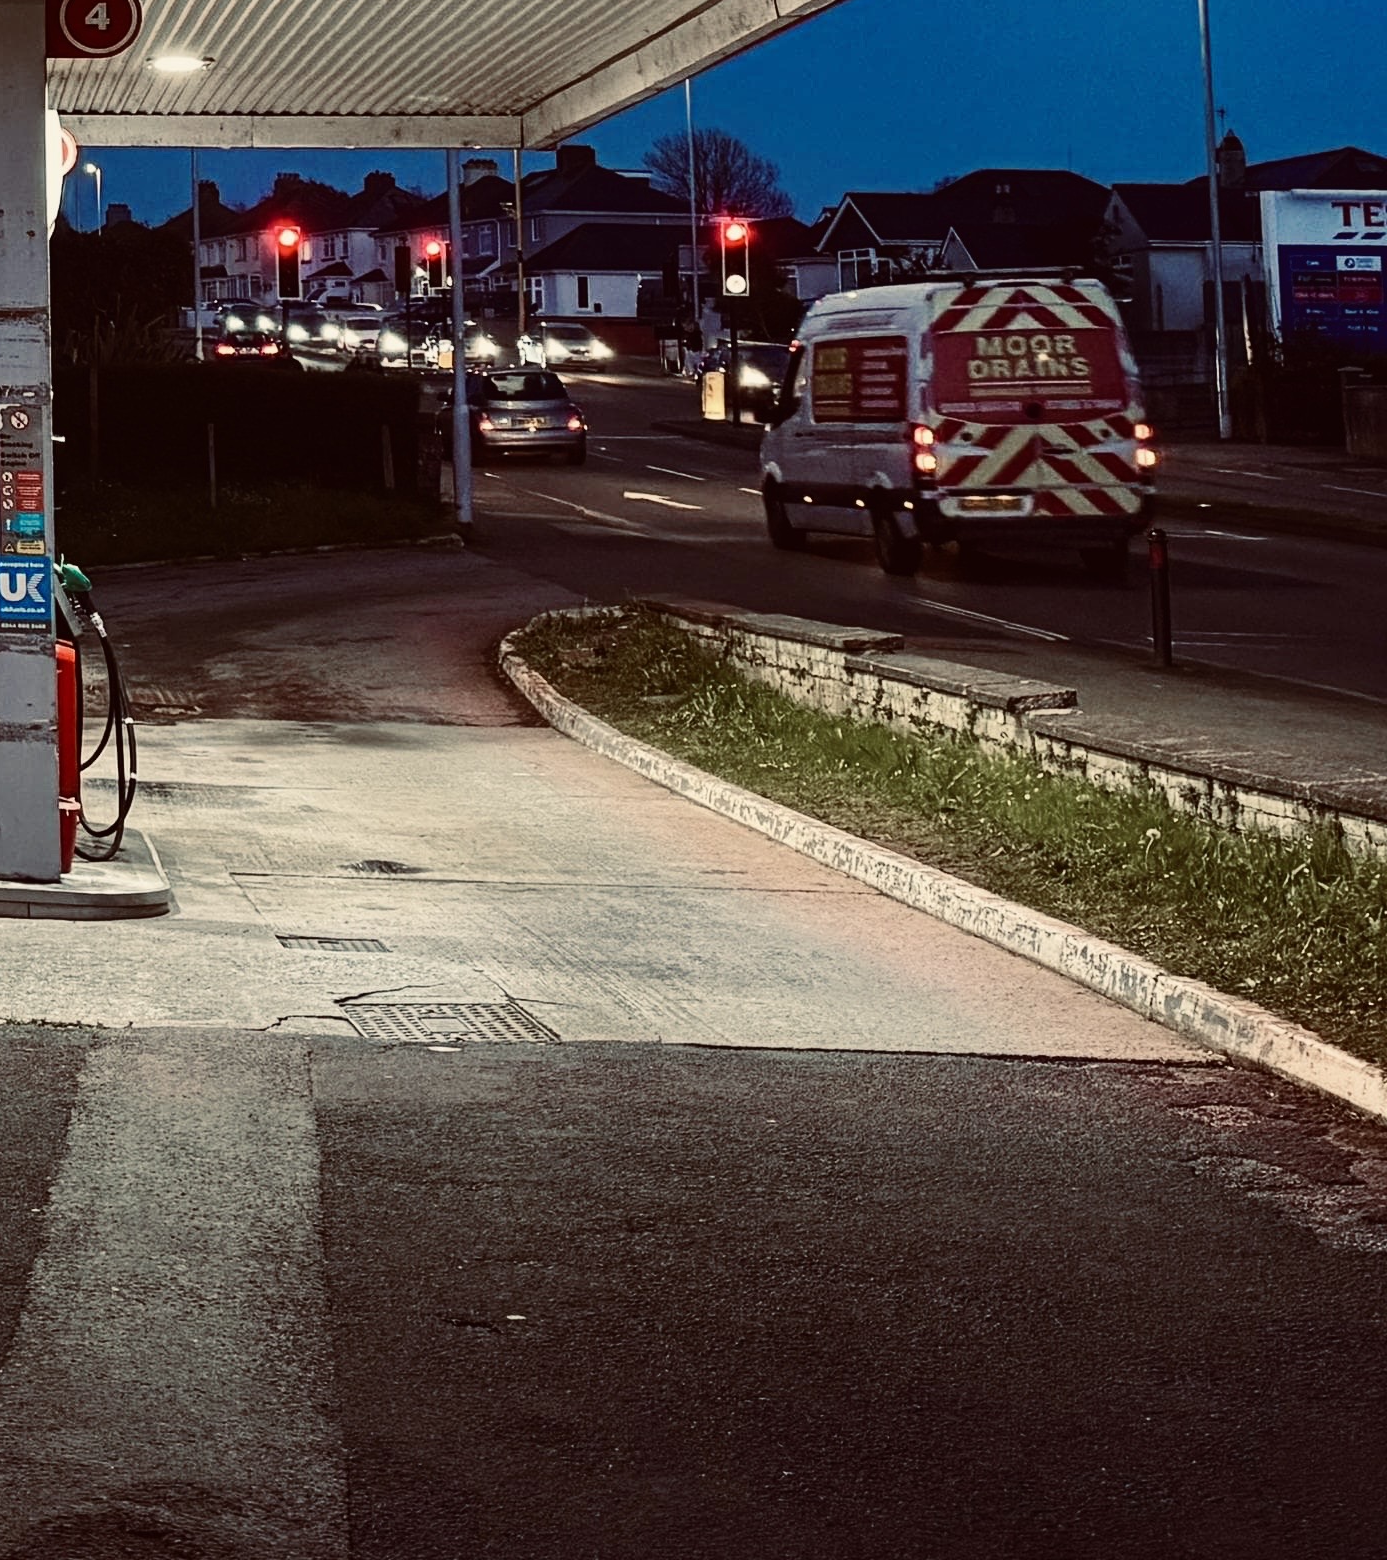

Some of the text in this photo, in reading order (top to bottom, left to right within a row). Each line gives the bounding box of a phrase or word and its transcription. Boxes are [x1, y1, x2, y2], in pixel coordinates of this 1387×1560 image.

[84, 2, 110, 31] 4
[1331, 200, 1387, 227] TE
[975, 334, 1077, 356] MOOR
[966, 357, 1090, 379] DRAINS
[0, 572, 46, 603] UK
